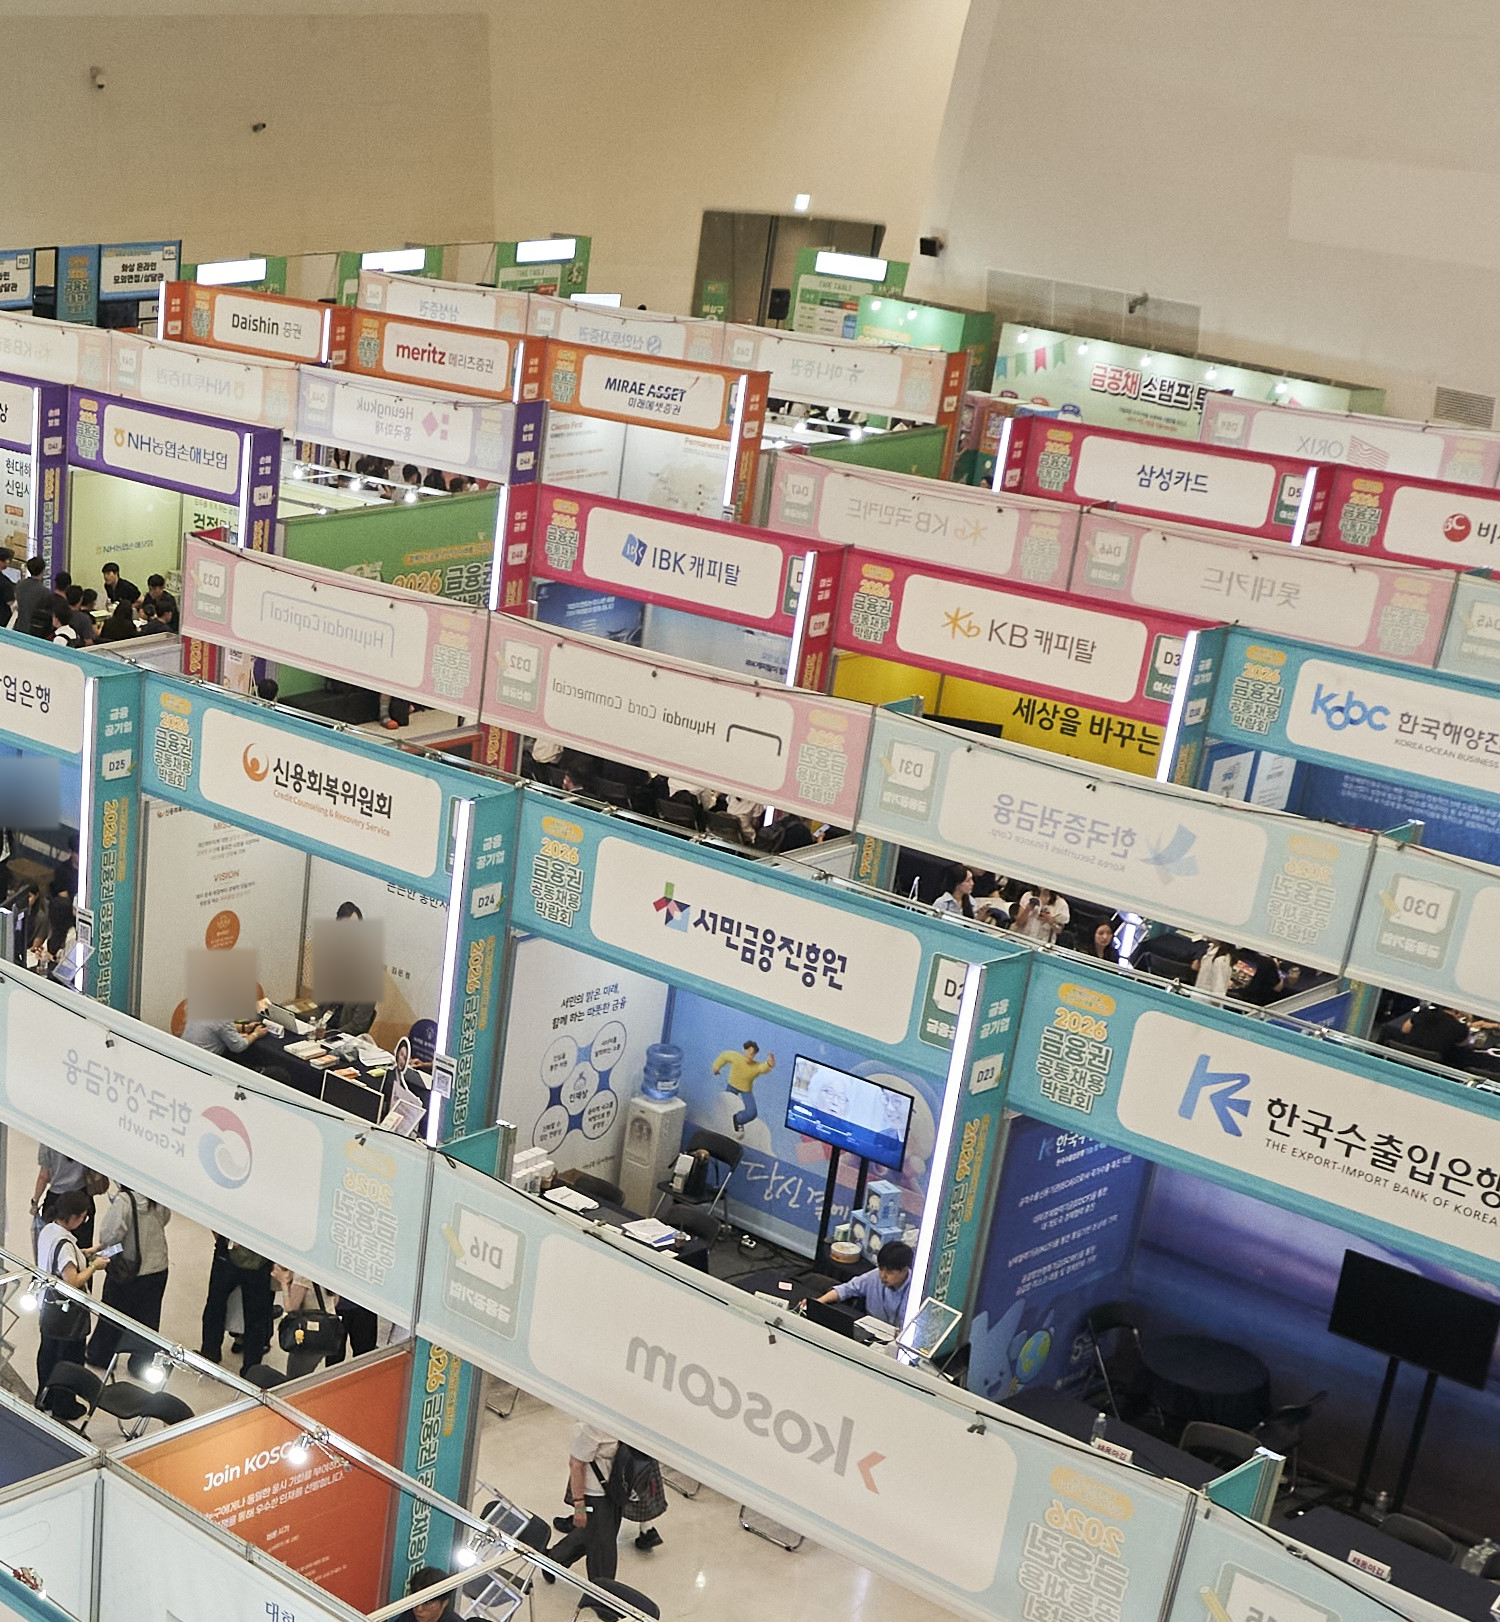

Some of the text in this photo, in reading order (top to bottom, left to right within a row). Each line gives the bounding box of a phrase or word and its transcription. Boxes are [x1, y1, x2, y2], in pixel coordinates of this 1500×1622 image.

[232, 312, 279, 335] Daishin
[395, 341, 495, 373] meritz 메리츠증권
[605, 377, 686, 403] MIRAE ASSET
[1089, 362, 1192, 409] 금공채 스탬프
[127, 433, 229, 470] NH농협손해보험
[1138, 464, 1209, 494] 삼성카드
[652, 547, 739, 586] IBK 캐피탈
[988, 618, 1098, 664] KB 캐피탈
[1012, 696, 1160, 755] 세상을 바꾸는
[272, 758, 392, 819] 신용회복위원회
[478, 894, 494, 908] D24
[692, 913, 848, 991] 서민금융진흥원
[1054, 1006, 1108, 1039] 2026
[1044, 1025, 1112, 1074] 금융권
[977, 1067, 995, 1082] D23
[1266, 1139, 1498, 1228] THE EXPORT-IMPORT BANK KOREA
[204, 1467, 240, 1492] Join
